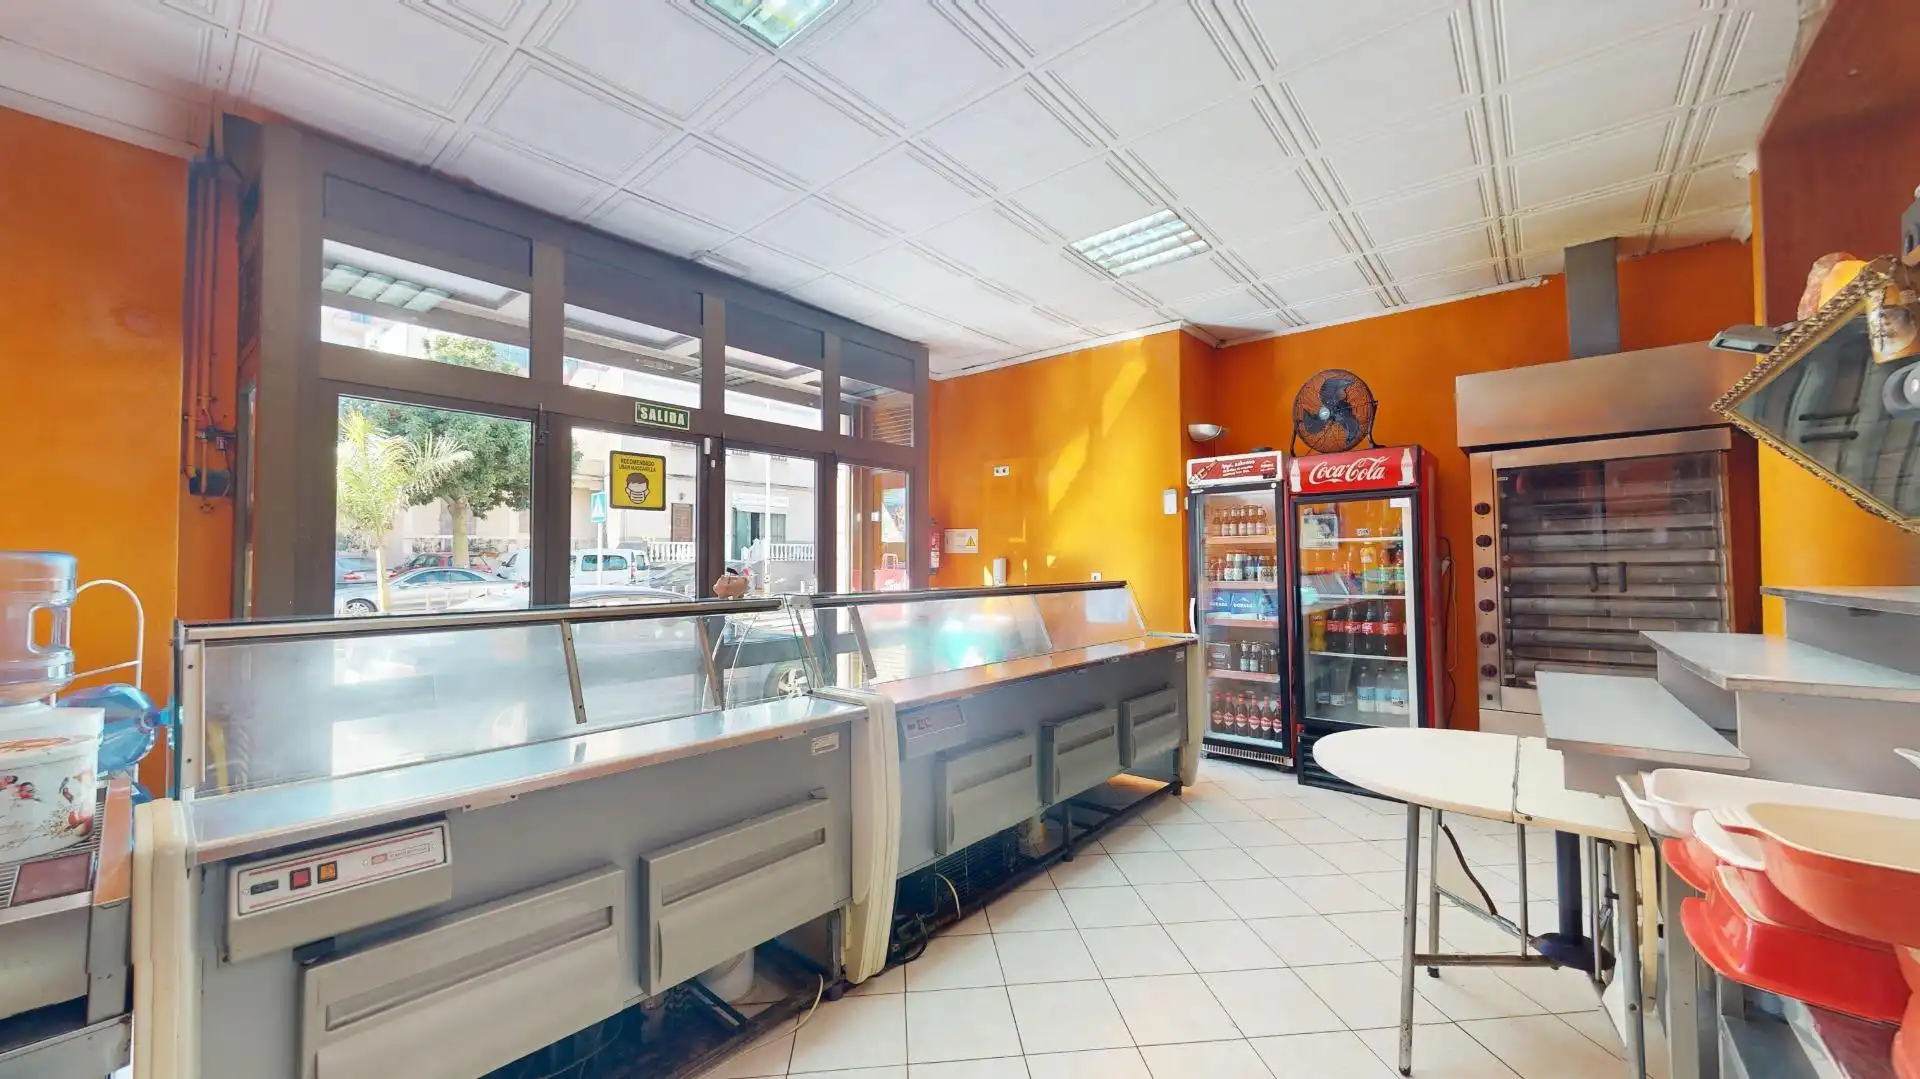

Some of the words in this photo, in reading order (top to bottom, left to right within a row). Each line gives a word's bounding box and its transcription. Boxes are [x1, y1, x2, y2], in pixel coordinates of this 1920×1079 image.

[640, 406, 685, 425] SALIDA
[621, 458, 655, 467] RECOMENDADO
[1308, 455, 1391, 485] Coca-Cola
